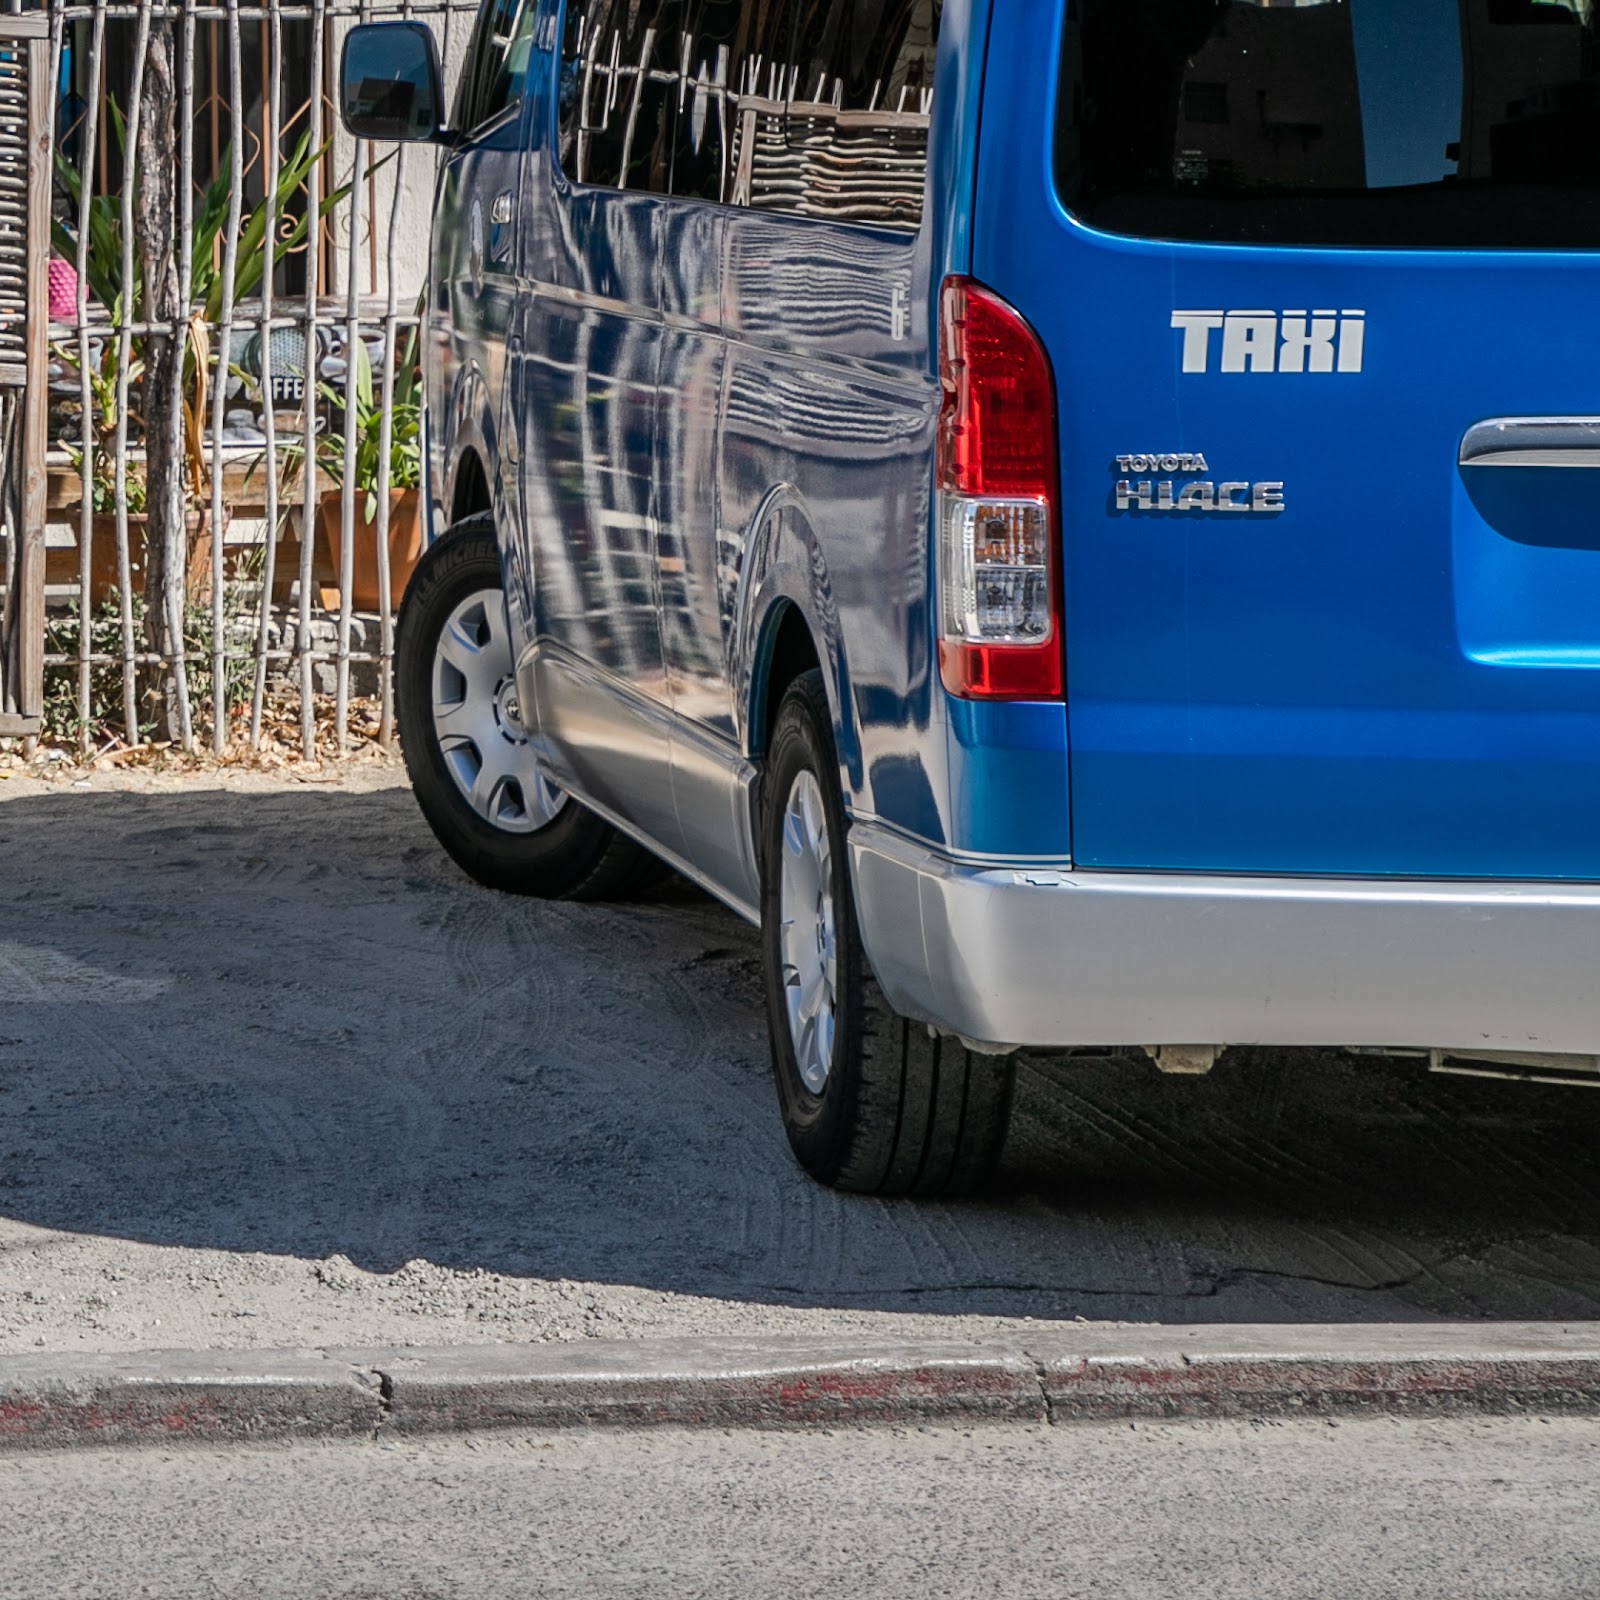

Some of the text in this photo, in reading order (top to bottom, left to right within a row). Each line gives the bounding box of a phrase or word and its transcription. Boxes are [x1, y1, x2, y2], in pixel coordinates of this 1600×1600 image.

[1170, 309, 1366, 373] TAXI
[1116, 452, 1209, 472] TOYOTA
[1116, 480, 1285, 511] HIACE
